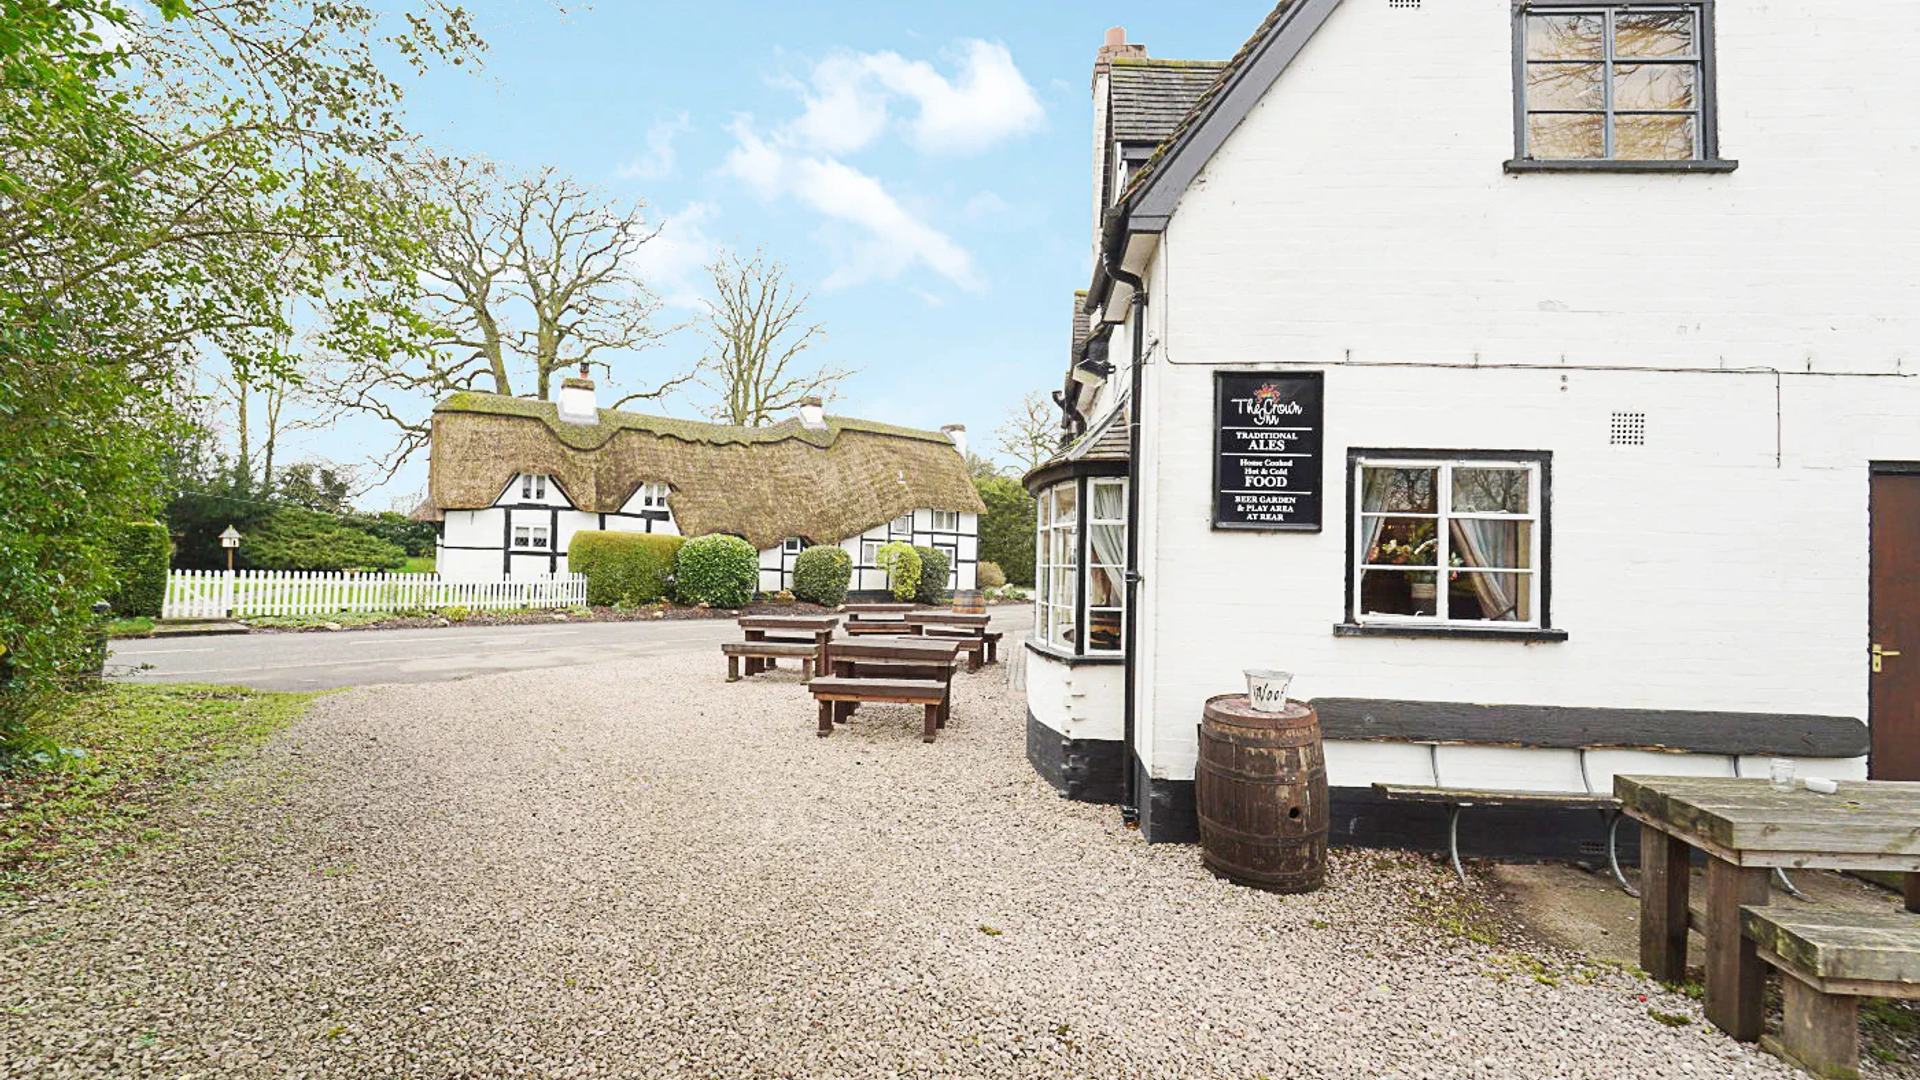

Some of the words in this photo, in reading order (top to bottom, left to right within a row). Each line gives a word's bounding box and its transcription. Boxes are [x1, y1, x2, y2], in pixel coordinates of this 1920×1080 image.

[1231, 398, 1260, 414] The
[1264, 398, 1303, 415] Crown
[1254, 407, 1279, 425] Inn
[1236, 431, 1298, 440] TRADITIONAL
[1248, 439, 1285, 451] ALES
[1240, 458, 1263, 467] Home
[1264, 458, 1293, 467] Cooked
[1245, 476, 1288, 487] FOOD
[1235, 495, 1258, 503] BEER
[1259, 496, 1296, 504] GARDEN
[1237, 504, 1245, 512] &
[1246, 504, 1269, 512] PLAY
[1270, 505, 1294, 513] AREA
[1246, 513, 1258, 521] AT
[1260, 513, 1284, 521] REAR
